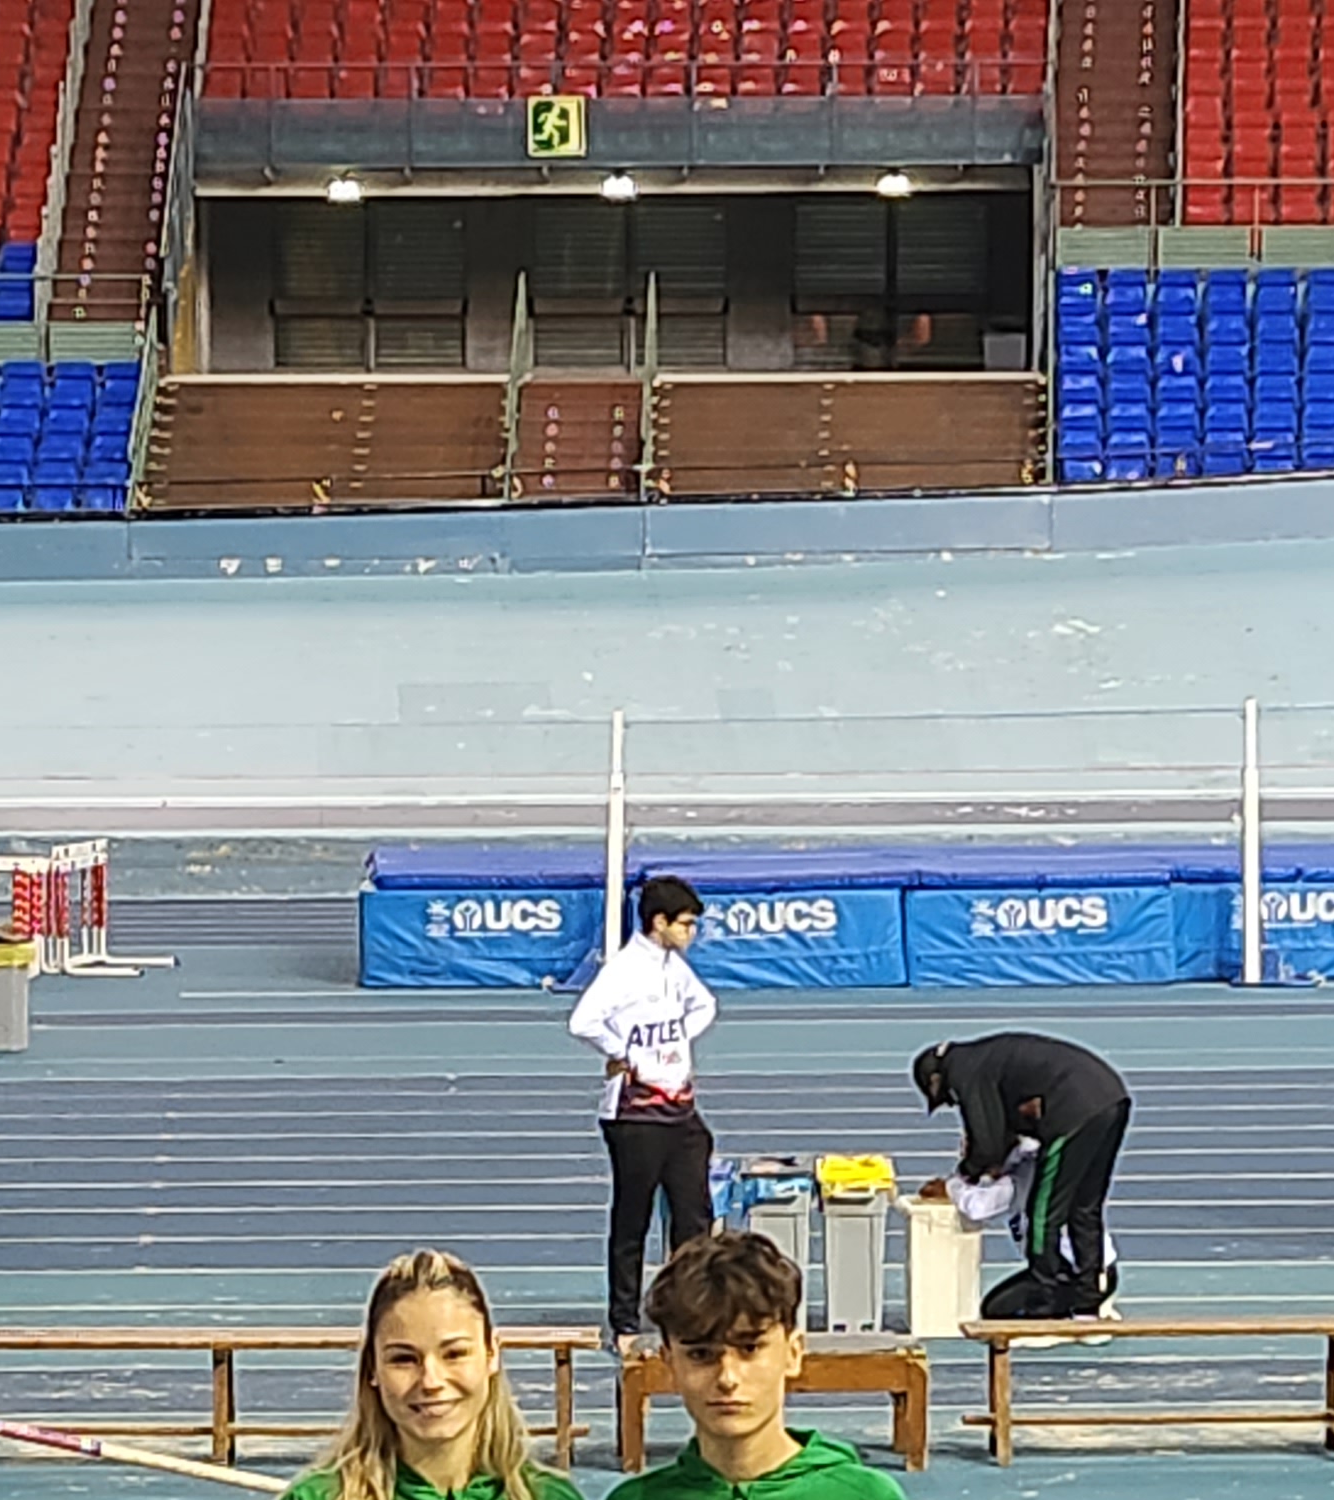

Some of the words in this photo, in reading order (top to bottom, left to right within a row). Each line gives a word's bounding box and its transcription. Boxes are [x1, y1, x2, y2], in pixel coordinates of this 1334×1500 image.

[484, 899, 562, 931] UCS
[758, 899, 837, 932] UCS
[1028, 896, 1107, 929] UCS
